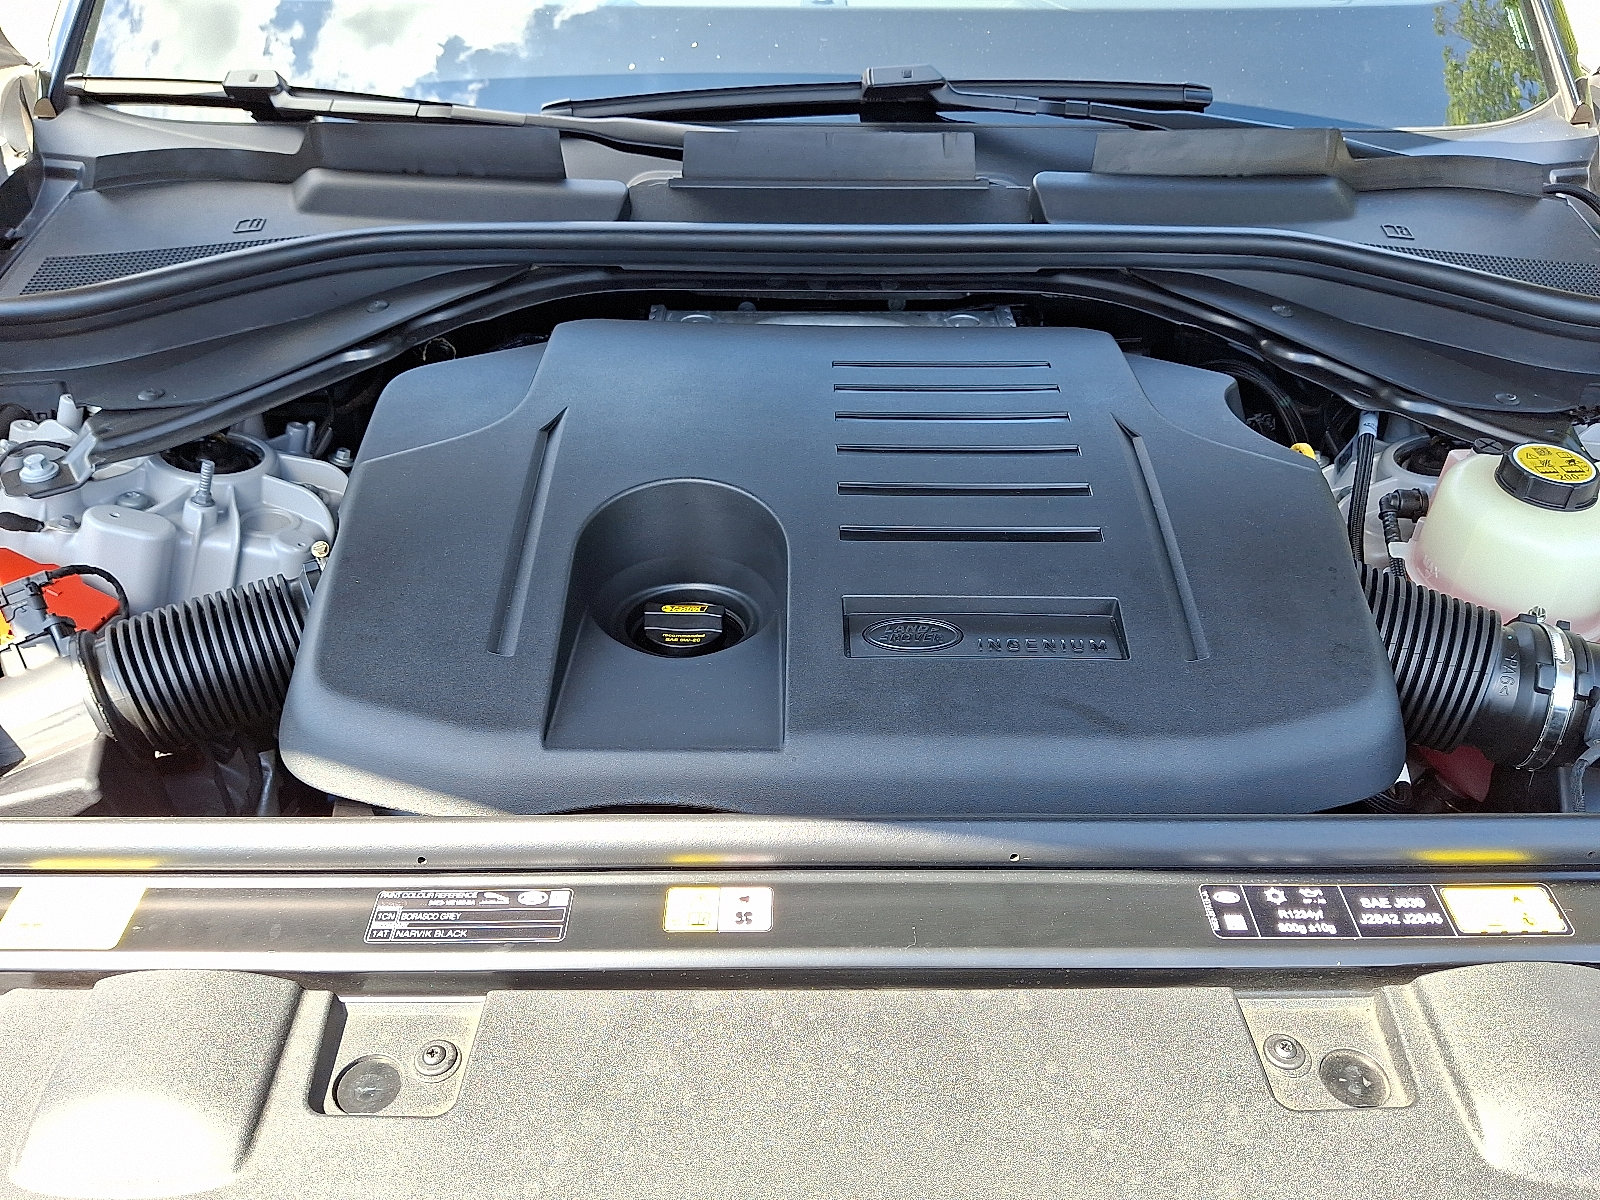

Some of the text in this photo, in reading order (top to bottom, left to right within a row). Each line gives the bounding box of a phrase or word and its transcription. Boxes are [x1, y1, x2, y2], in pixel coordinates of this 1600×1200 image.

[884, 624, 931, 634] LAND
[889, 632, 945, 644] ROVER
[976, 638, 1108, 653] INGENIUM
[380, 891, 479, 899] PAINT COLOUR REFERENCE
[1360, 897, 1393, 909] SAE
[400, 912, 439, 921] BORASCO
[439, 912, 463, 921] GREY
[372, 929, 468, 938] 1AT NARVIK BLACK
